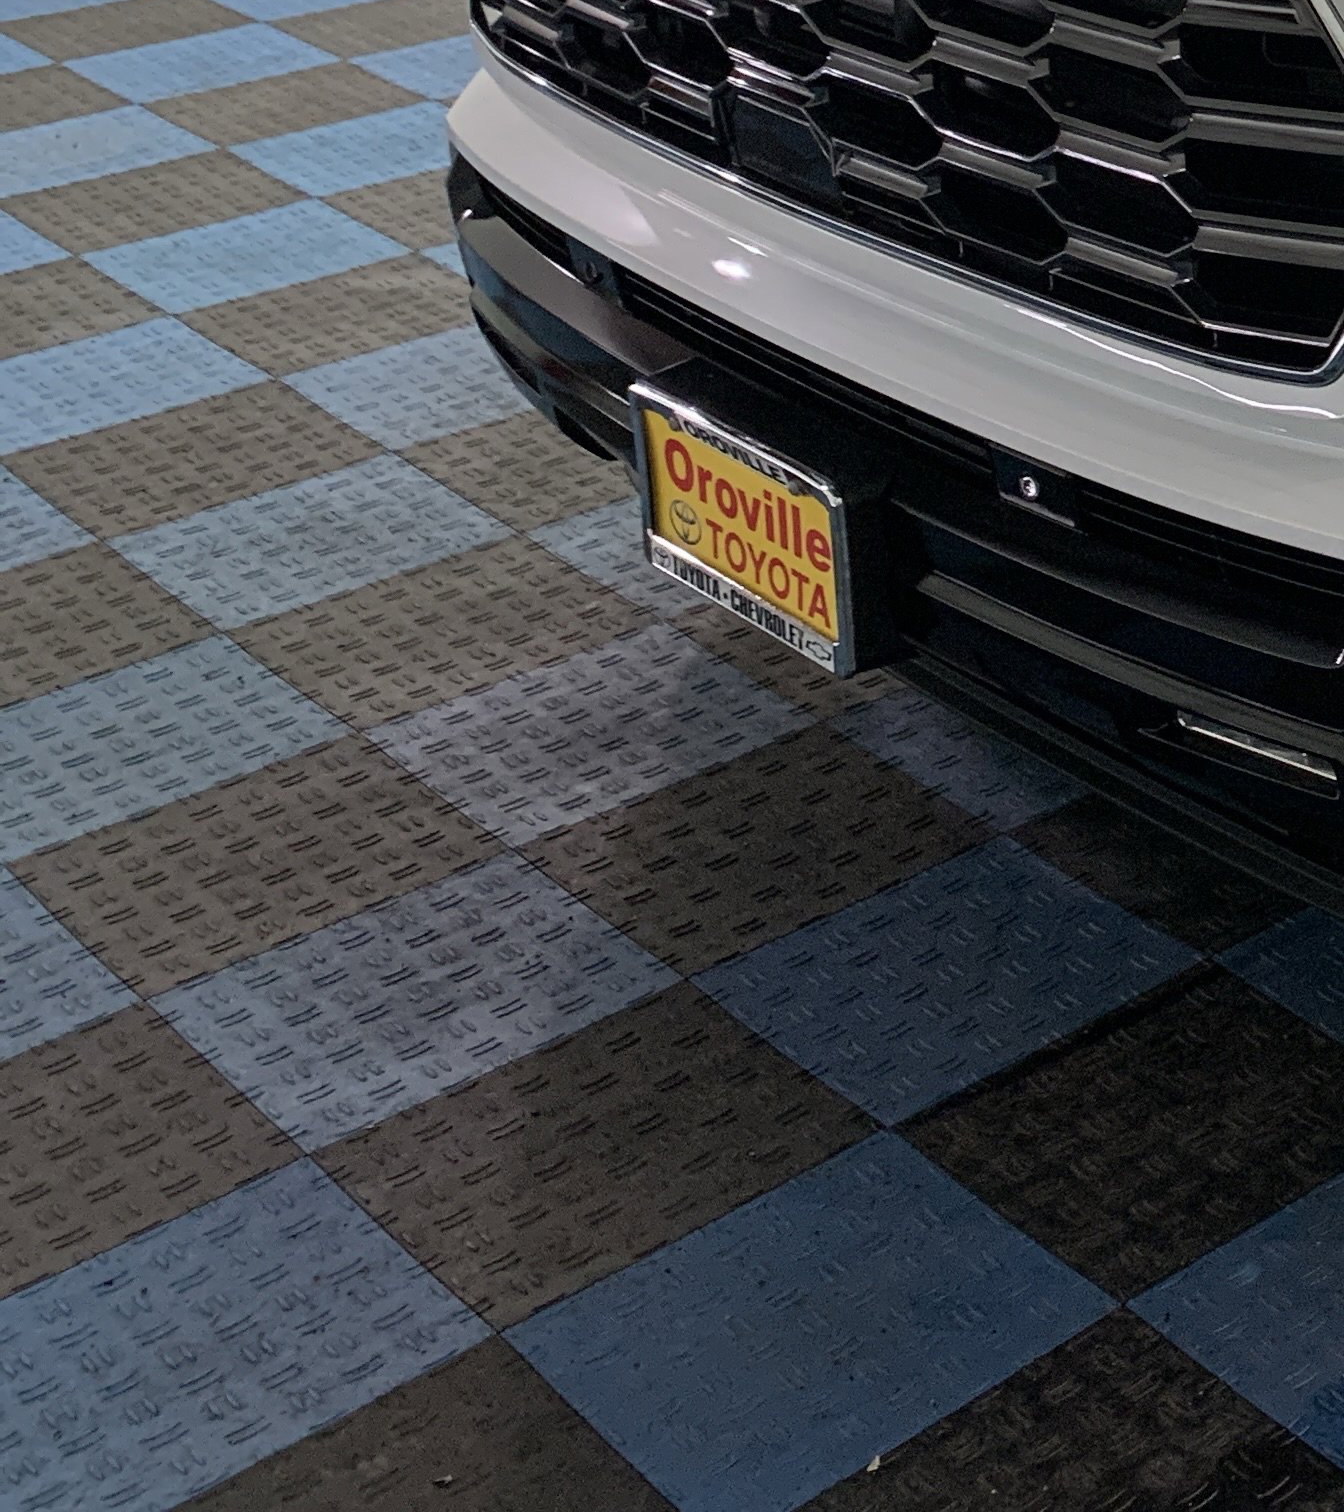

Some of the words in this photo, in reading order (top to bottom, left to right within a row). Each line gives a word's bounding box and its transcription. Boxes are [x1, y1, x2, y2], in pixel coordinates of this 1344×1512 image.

[685, 419, 789, 486] OROVILLE
[664, 438, 832, 573] Oroville
[673, 556, 721, 602] TOYOTA
[730, 593, 805, 651] CHEVROLET
[705, 519, 832, 629] TOYOTA
